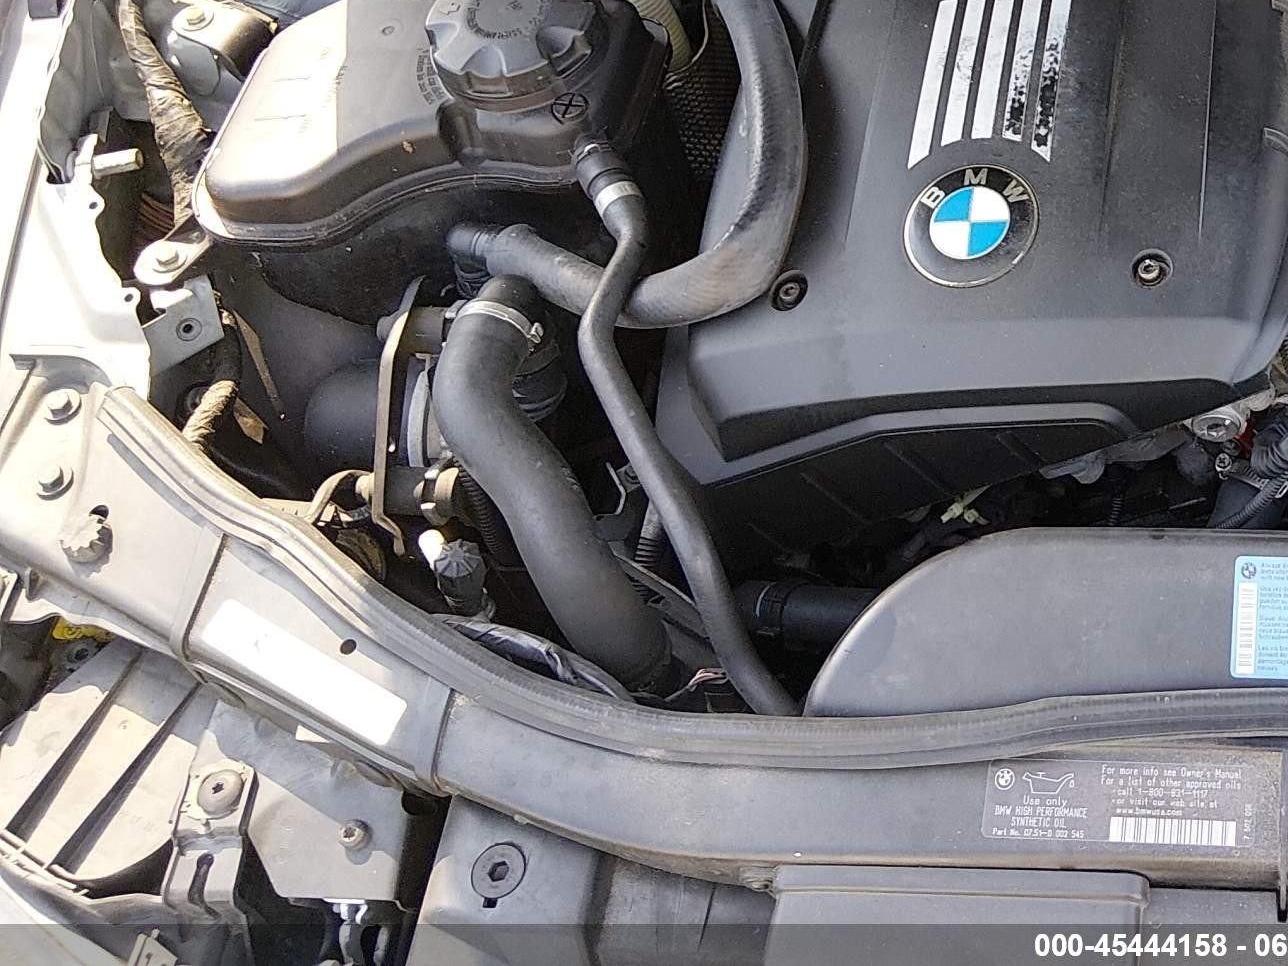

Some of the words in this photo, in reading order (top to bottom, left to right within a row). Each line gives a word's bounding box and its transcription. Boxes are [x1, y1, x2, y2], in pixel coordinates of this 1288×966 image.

[920, 168, 1029, 209] BMW
[1102, 764, 1115, 775] For
[1120, 767, 1138, 776] more
[1143, 766, 1158, 776] info
[1163, 769, 1177, 777] see
[1215, 769, 1241, 779] Manual
[1101, 775, 1114, 785] For
[1128, 776, 1142, 786] list
[1147, 777, 1156, 787] of
[1160, 778, 1182, 787] other
[1185, 780, 1221, 790] approved
[1225, 781, 1241, 790] oils
[1023, 795, 1041, 806] Use
[1046, 796, 1068, 808] only
[1130, 797, 1148, 805] visit
[994, 805, 1012, 816] BMW
[1015, 805, 1033, 816] HIGH
[1036, 806, 1088, 819] PERFORMANCE
[1011, 816, 1051, 827] SYNTHETIC
[1053, 818, 1067, 828] OIL
[992, 827, 1007, 836] Part
